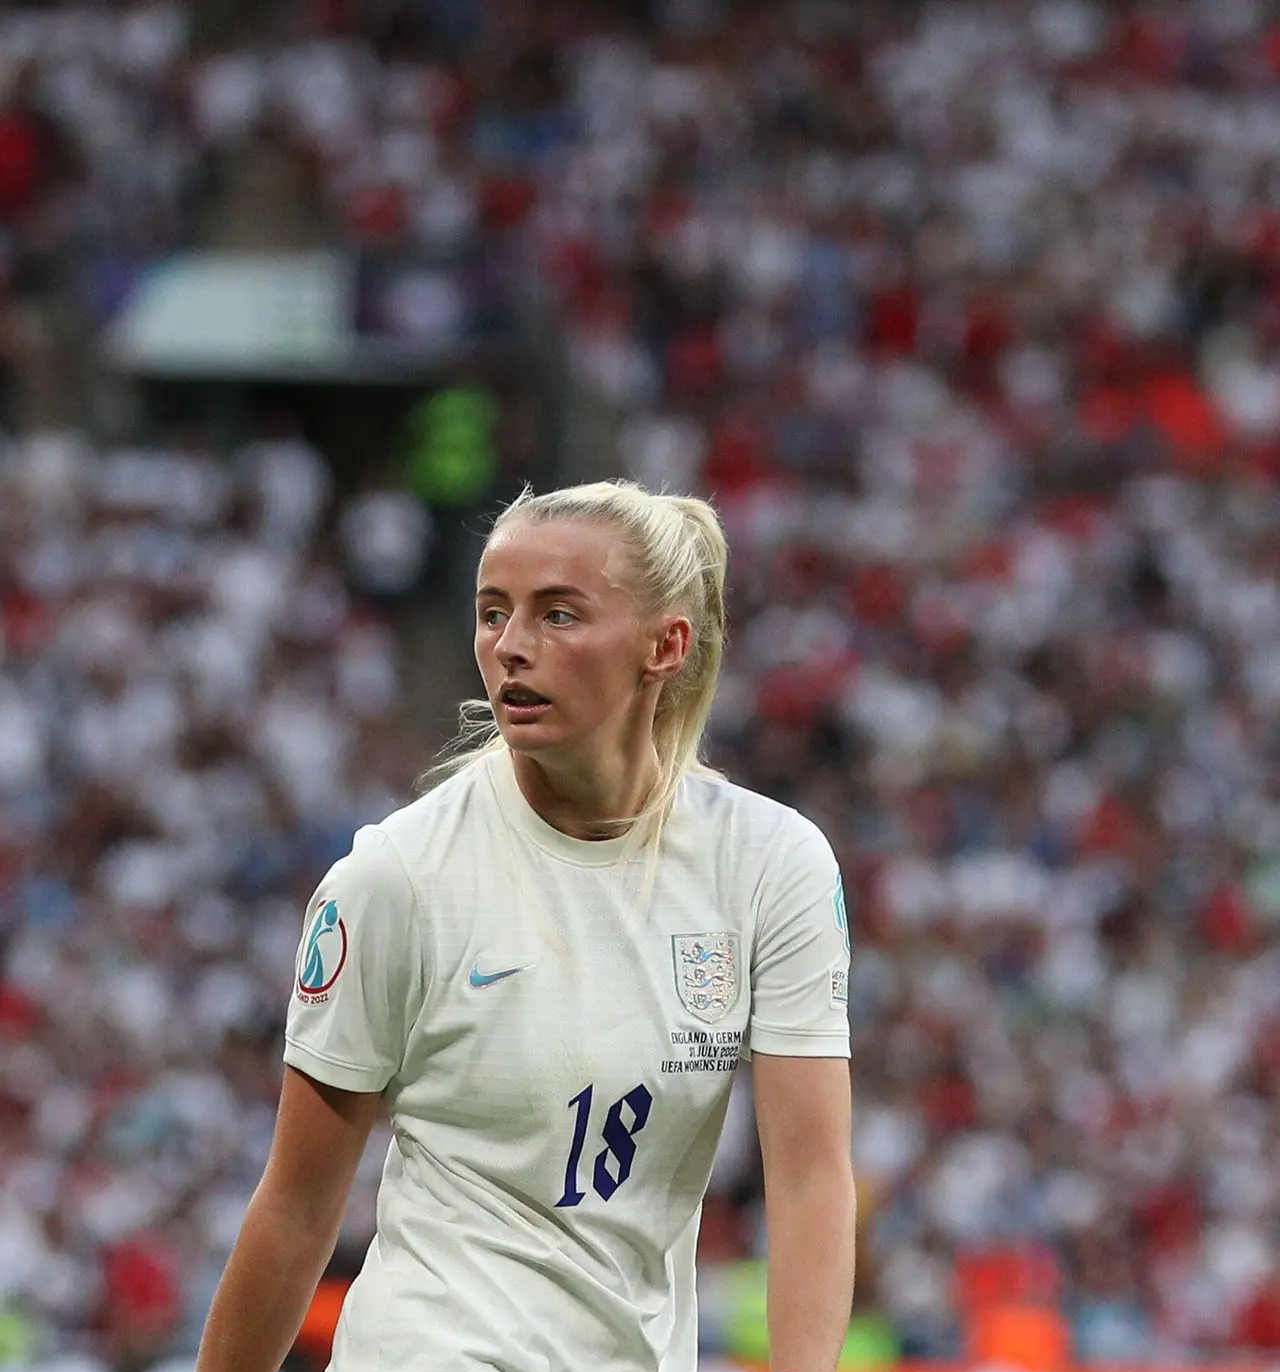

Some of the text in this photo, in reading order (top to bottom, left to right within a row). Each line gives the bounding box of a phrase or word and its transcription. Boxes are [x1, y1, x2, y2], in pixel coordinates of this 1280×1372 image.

[310, 993, 329, 1004] 2022
[671, 1031, 708, 1044] ENGLAND
[697, 1046, 720, 1058] JULY
[720, 1046, 739, 1058] 2022
[661, 1060, 683, 1073] UEFA
[684, 1059, 716, 1072] WOMENS
[553, 1083, 653, 1208] 18
